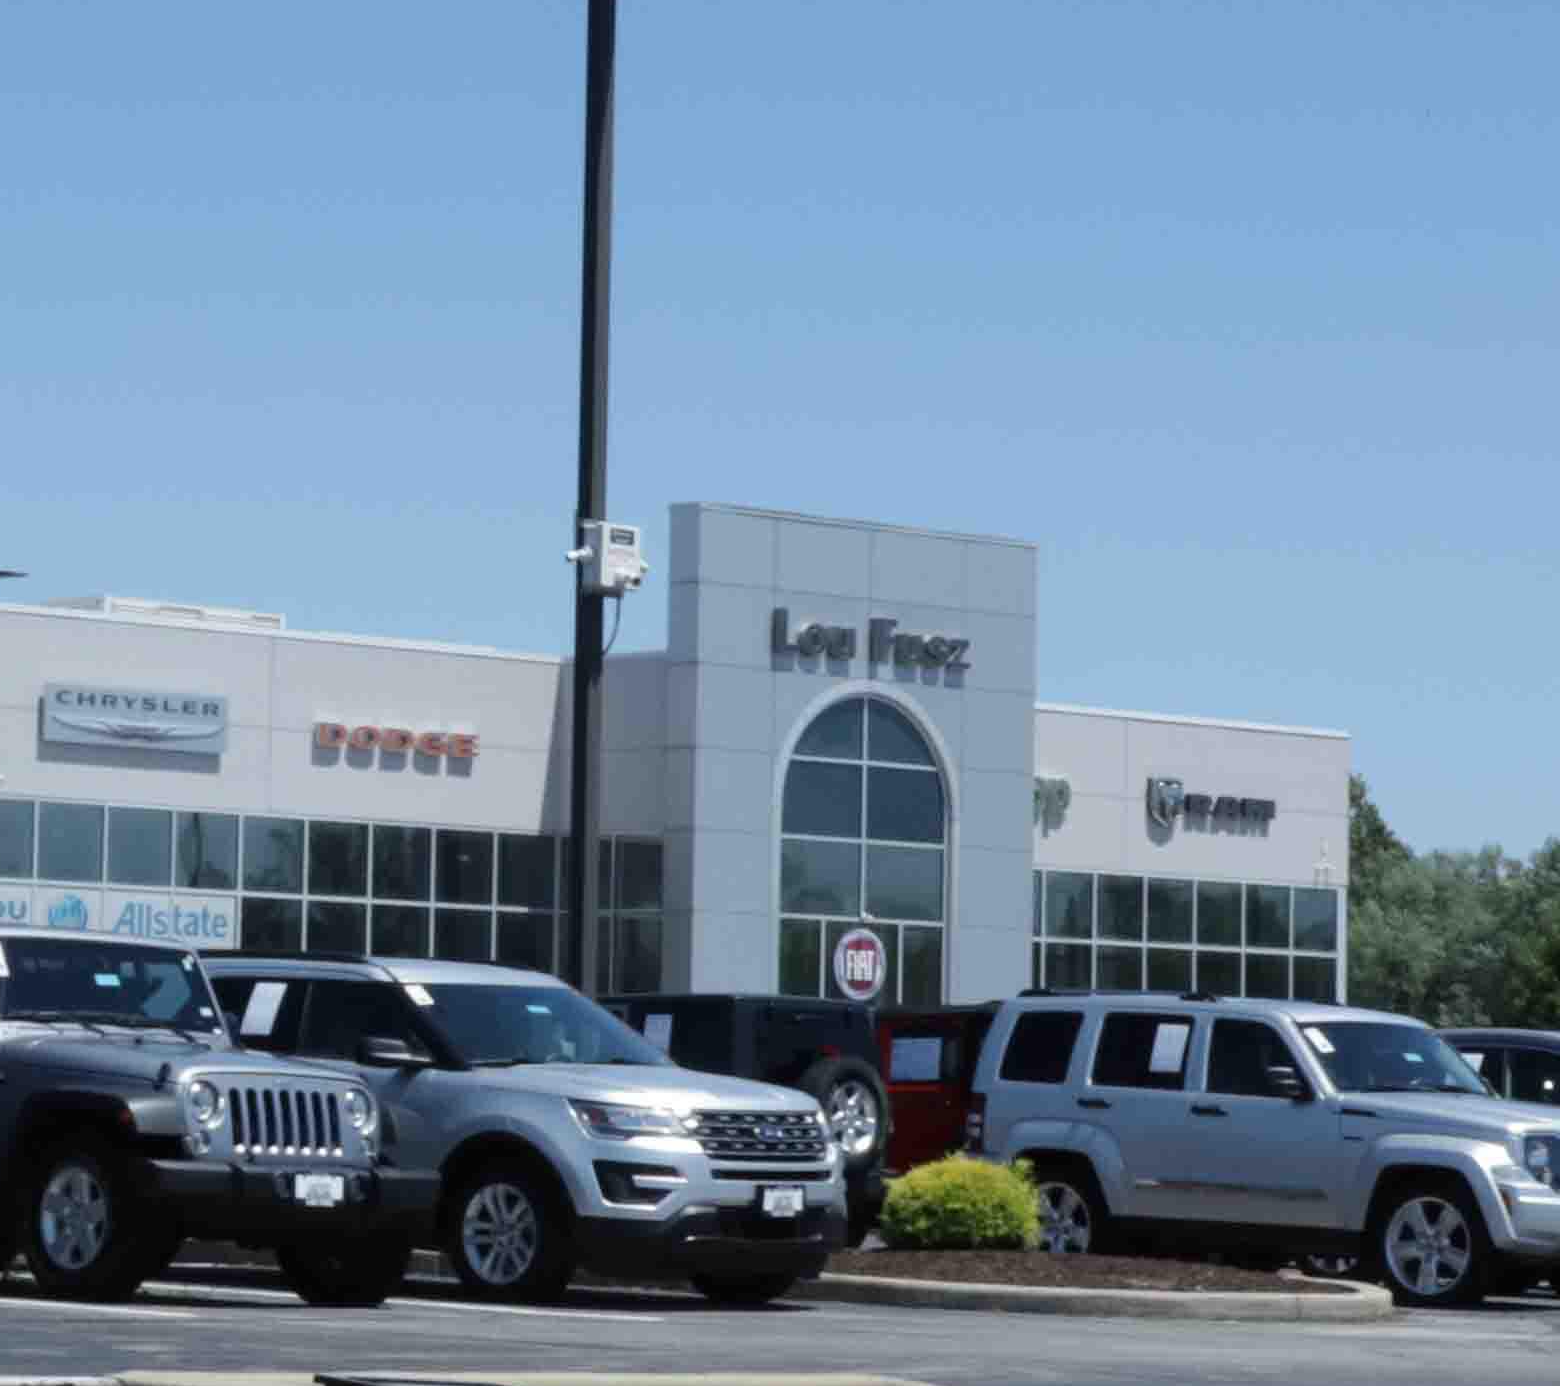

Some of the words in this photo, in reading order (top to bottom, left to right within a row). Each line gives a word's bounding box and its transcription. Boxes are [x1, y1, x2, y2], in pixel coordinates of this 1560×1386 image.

[770, 606, 856, 660] Lou
[868, 617, 972, 671] Fusz
[55, 690, 220, 717] CHRYSLER
[313, 723, 480, 758] DODGE
[1183, 793, 1276, 820] RAM
[110, 900, 229, 939] Allstate
[847, 949, 873, 981] FIAT
